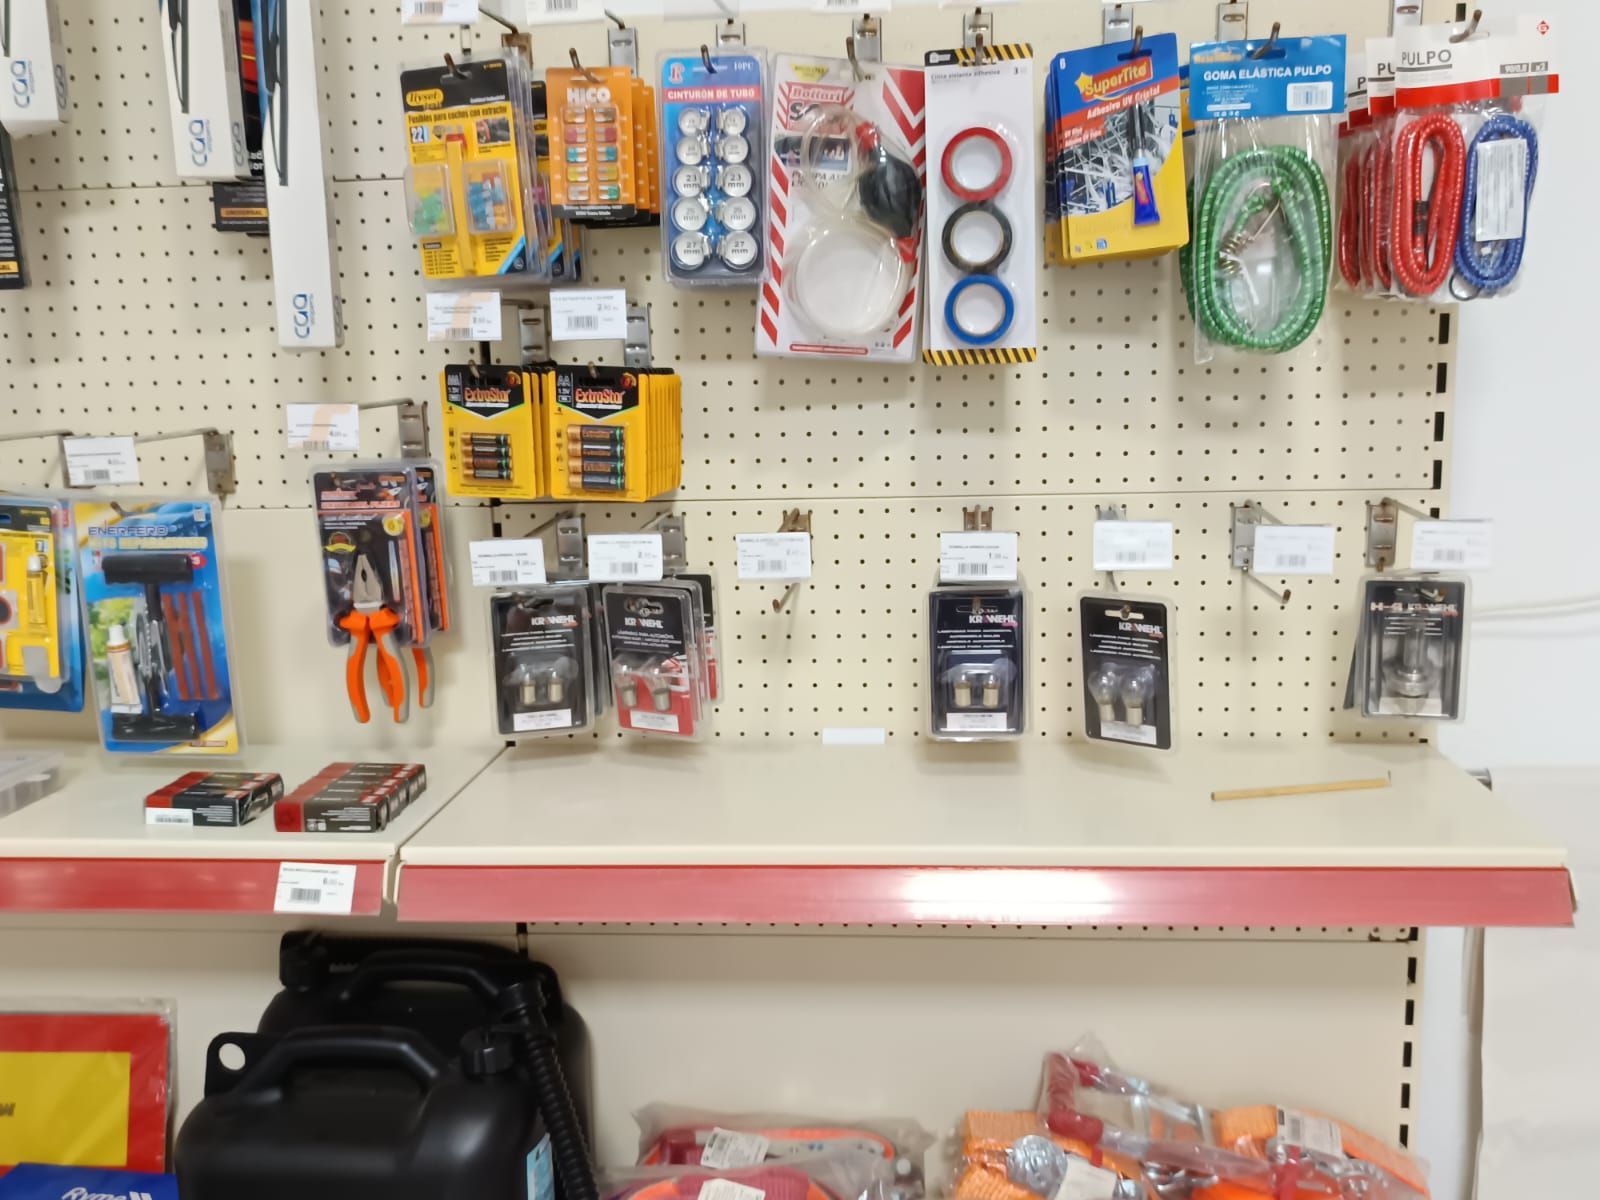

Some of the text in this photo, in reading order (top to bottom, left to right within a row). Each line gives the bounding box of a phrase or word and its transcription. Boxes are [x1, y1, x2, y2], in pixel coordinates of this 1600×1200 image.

[1401, 49, 1452, 66] PULPO
[1203, 64, 1332, 81] GOMA ELÁSTICA PULPO
[716, 89, 728, 98] DE
[730, 88, 755, 97] TUBO
